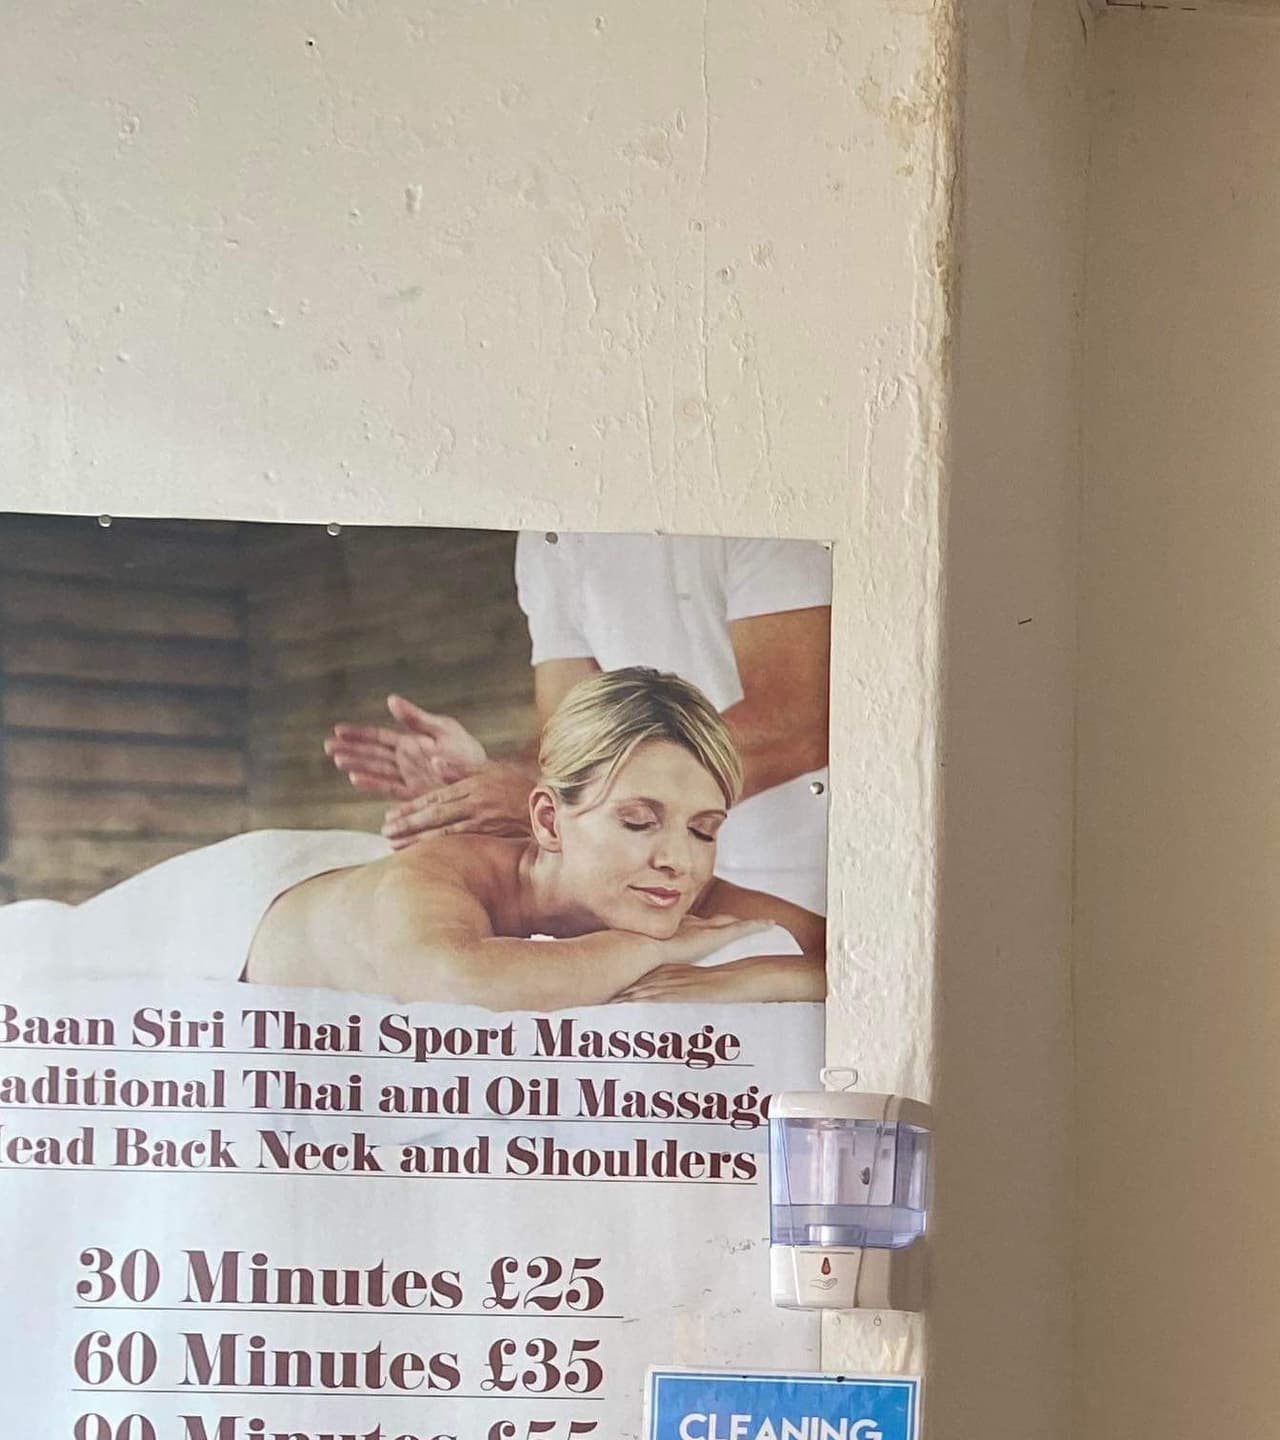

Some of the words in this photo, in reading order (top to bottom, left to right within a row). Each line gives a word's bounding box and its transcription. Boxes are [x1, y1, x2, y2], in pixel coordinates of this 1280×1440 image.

[0, 1004, 115, 1046] Baan
[132, 1007, 226, 1048] Siri
[242, 1010, 363, 1052] Thai
[379, 1013, 517, 1062] Sport
[532, 1018, 741, 1069] Massage
[0, 1065, 227, 1107] aditional
[242, 1069, 362, 1111] Thai
[380, 1076, 470, 1115] and
[485, 1075, 561, 1116] Oil
[0, 1124, 97, 1166] ead
[113, 1127, 239, 1168] Back
[255, 1130, 385, 1171] Neck
[400, 1135, 491, 1174] and
[506, 1135, 758, 1180] Shoulders
[75, 1247, 160, 1303] 30
[180, 1249, 465, 1309] Minutes
[481, 1256, 606, 1313] £25
[74, 1330, 158, 1385] 60
[178, 1333, 462, 1391] Minutes
[479, 1337, 605, 1394] £35
